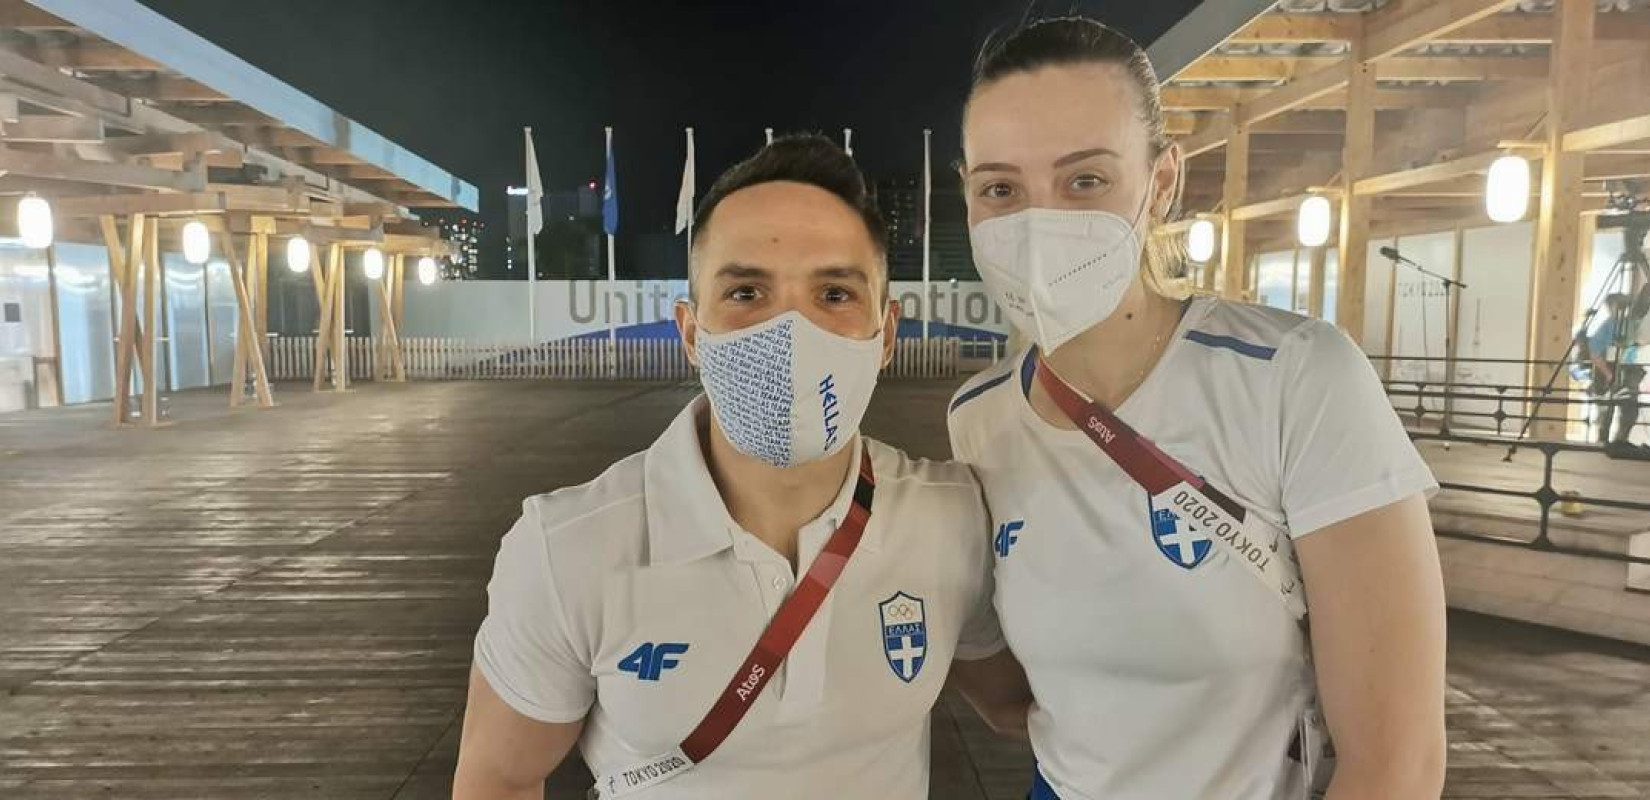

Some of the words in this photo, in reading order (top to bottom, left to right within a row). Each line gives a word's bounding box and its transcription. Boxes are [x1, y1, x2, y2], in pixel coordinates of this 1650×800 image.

[570, 280, 688, 324] Unit
[1173, 490, 1220, 528] 2020
[995, 520, 1024, 557] 4F
[1215, 522, 1270, 573] TOKYO
[617, 642, 690, 680] 4F
[736, 664, 766, 702] Atos
[622, 765, 659, 786] TOKYO
